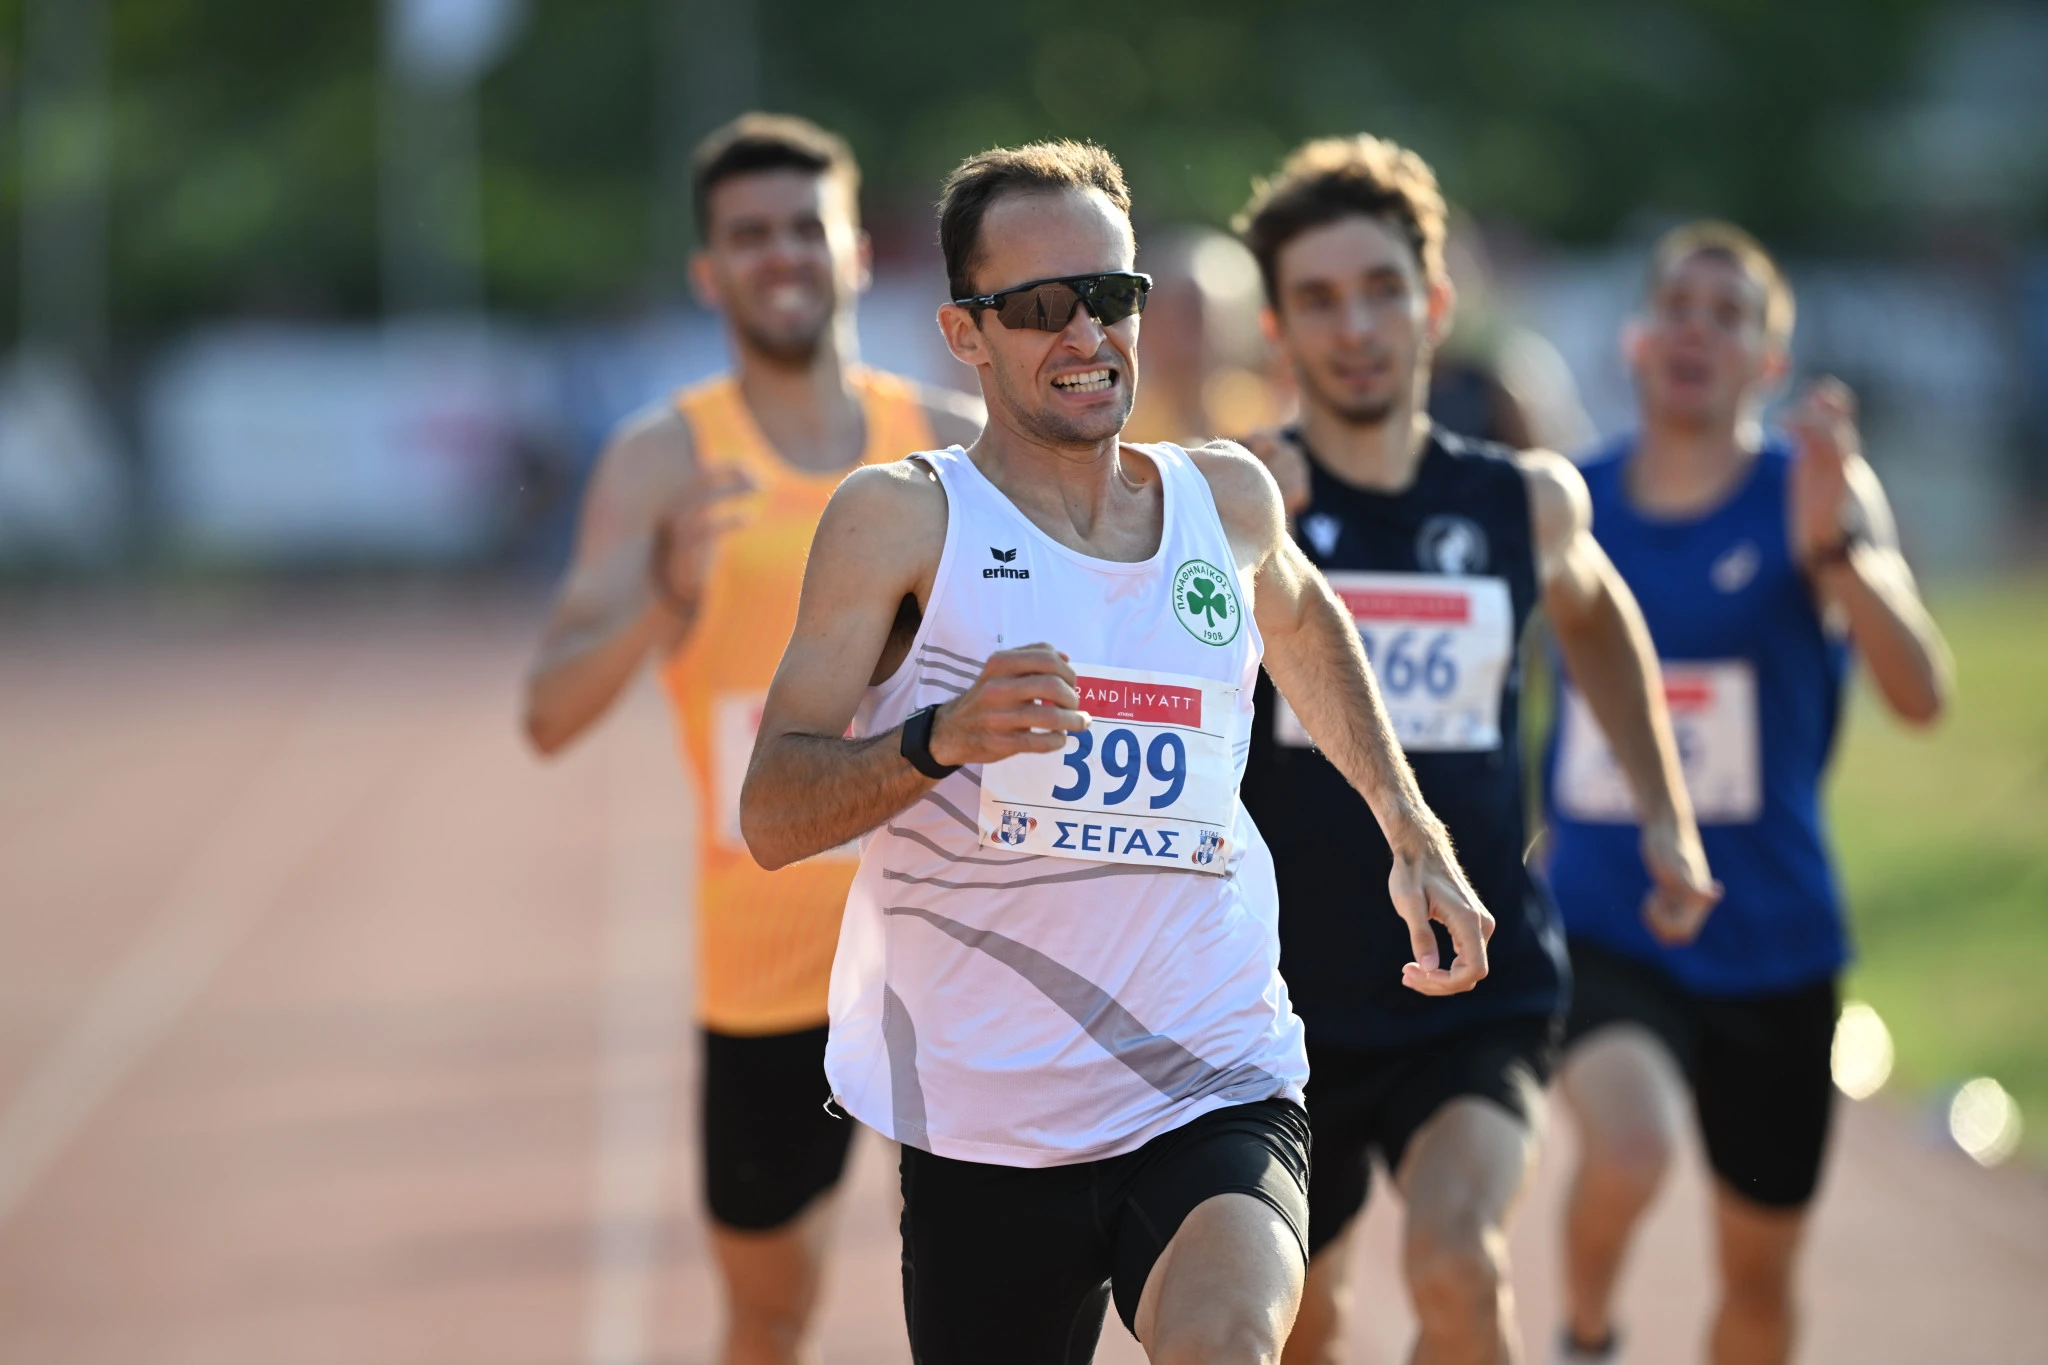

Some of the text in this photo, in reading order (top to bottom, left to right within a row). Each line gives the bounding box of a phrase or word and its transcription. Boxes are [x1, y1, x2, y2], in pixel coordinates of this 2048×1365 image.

[983, 566, 1029, 579] erima
[1204, 630, 1223, 640] 1908
[1363, 629, 1457, 698] 66
[1075, 687, 1191, 710] RAND HYATT
[1052, 728, 1186, 809] 399
[1003, 809, 1027, 818] ΣΕΓΑΣ
[1052, 821, 1179, 859] ΣΕΓΑΣ
[1200, 829, 1220, 838] ΣΕΓΑΣ
